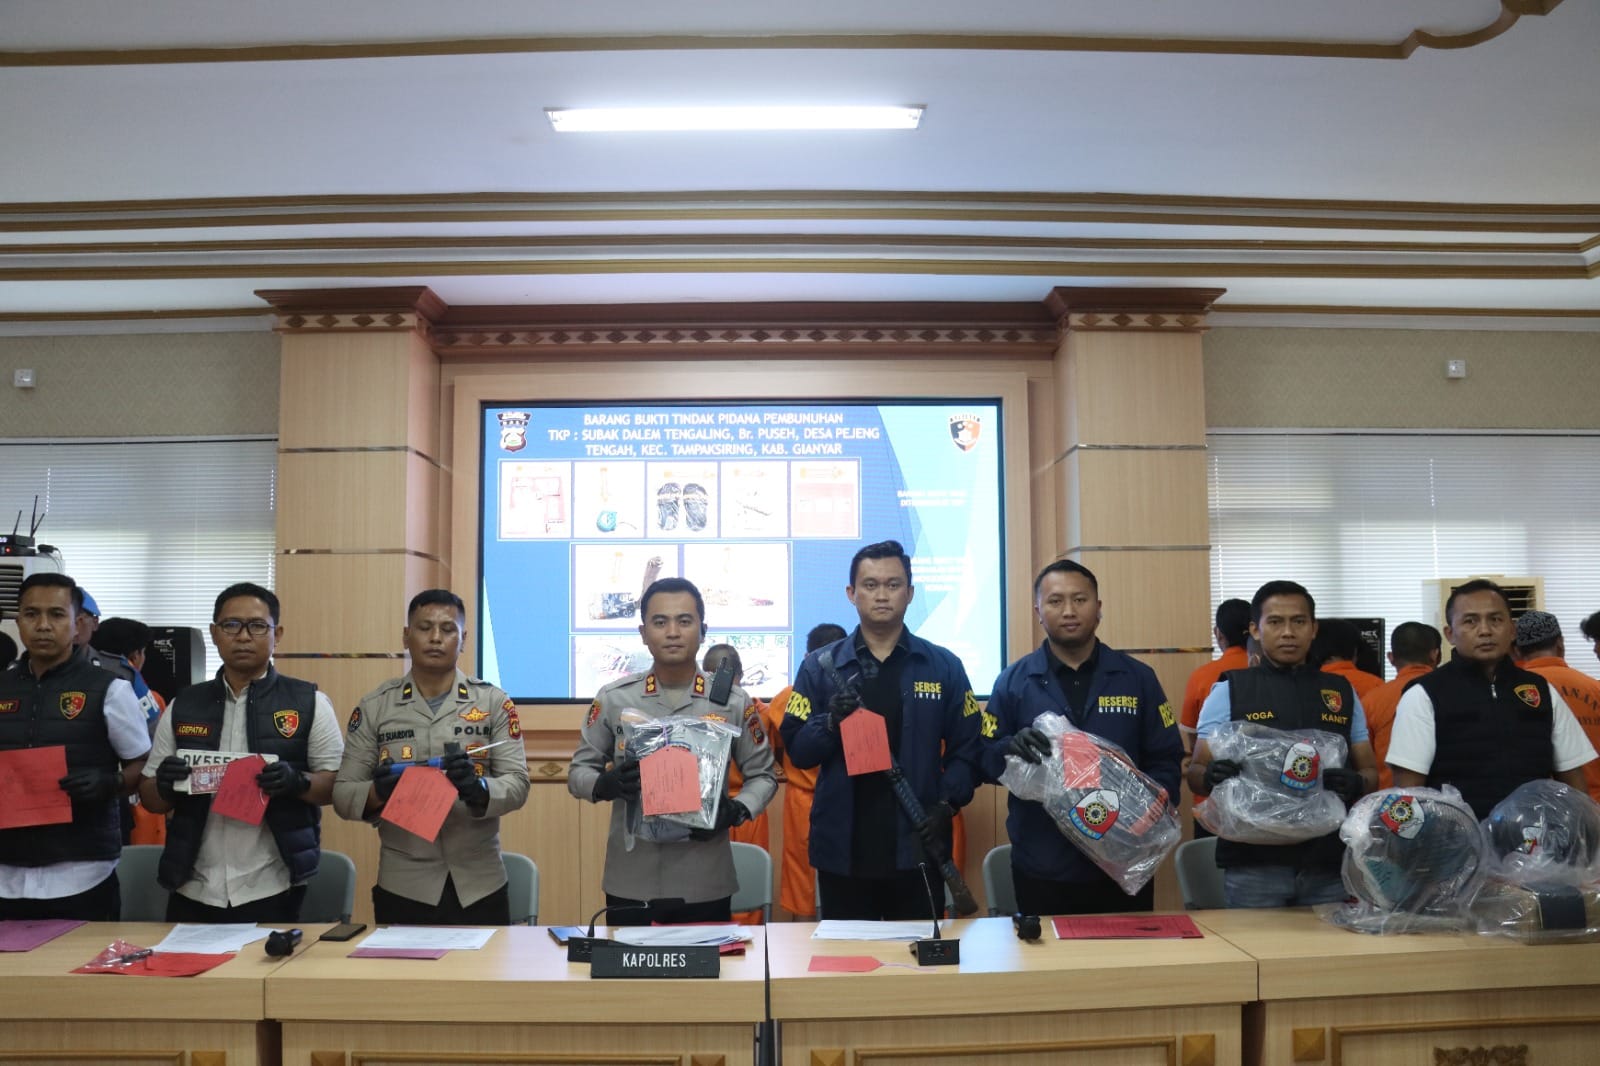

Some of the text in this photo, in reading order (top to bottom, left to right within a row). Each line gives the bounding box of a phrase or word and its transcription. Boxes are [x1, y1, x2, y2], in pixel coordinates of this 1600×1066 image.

[584, 413, 843, 426] BARANG BUKTI TINDAK PIDANA PEMBUNUHAN
[548, 429, 570, 441] TKP
[582, 429, 619, 441] SUBAK
[622, 429, 661, 440] DALEM
[664, 429, 734, 442] TENGALING,
[738, 428, 754, 440] Br.
[758, 428, 799, 441] PUSEH,
[804, 428, 833, 439] DESA
[836, 428, 880, 439] PEJENG
[585, 443, 843, 457] TENGAH, KEC. TAMPAKSIRING, KAB. GIANYAR
[1246, 710, 1274, 721] YOGA
[1321, 712, 1348, 724] KANIT
[622, 953, 687, 968] KAPOLRES
